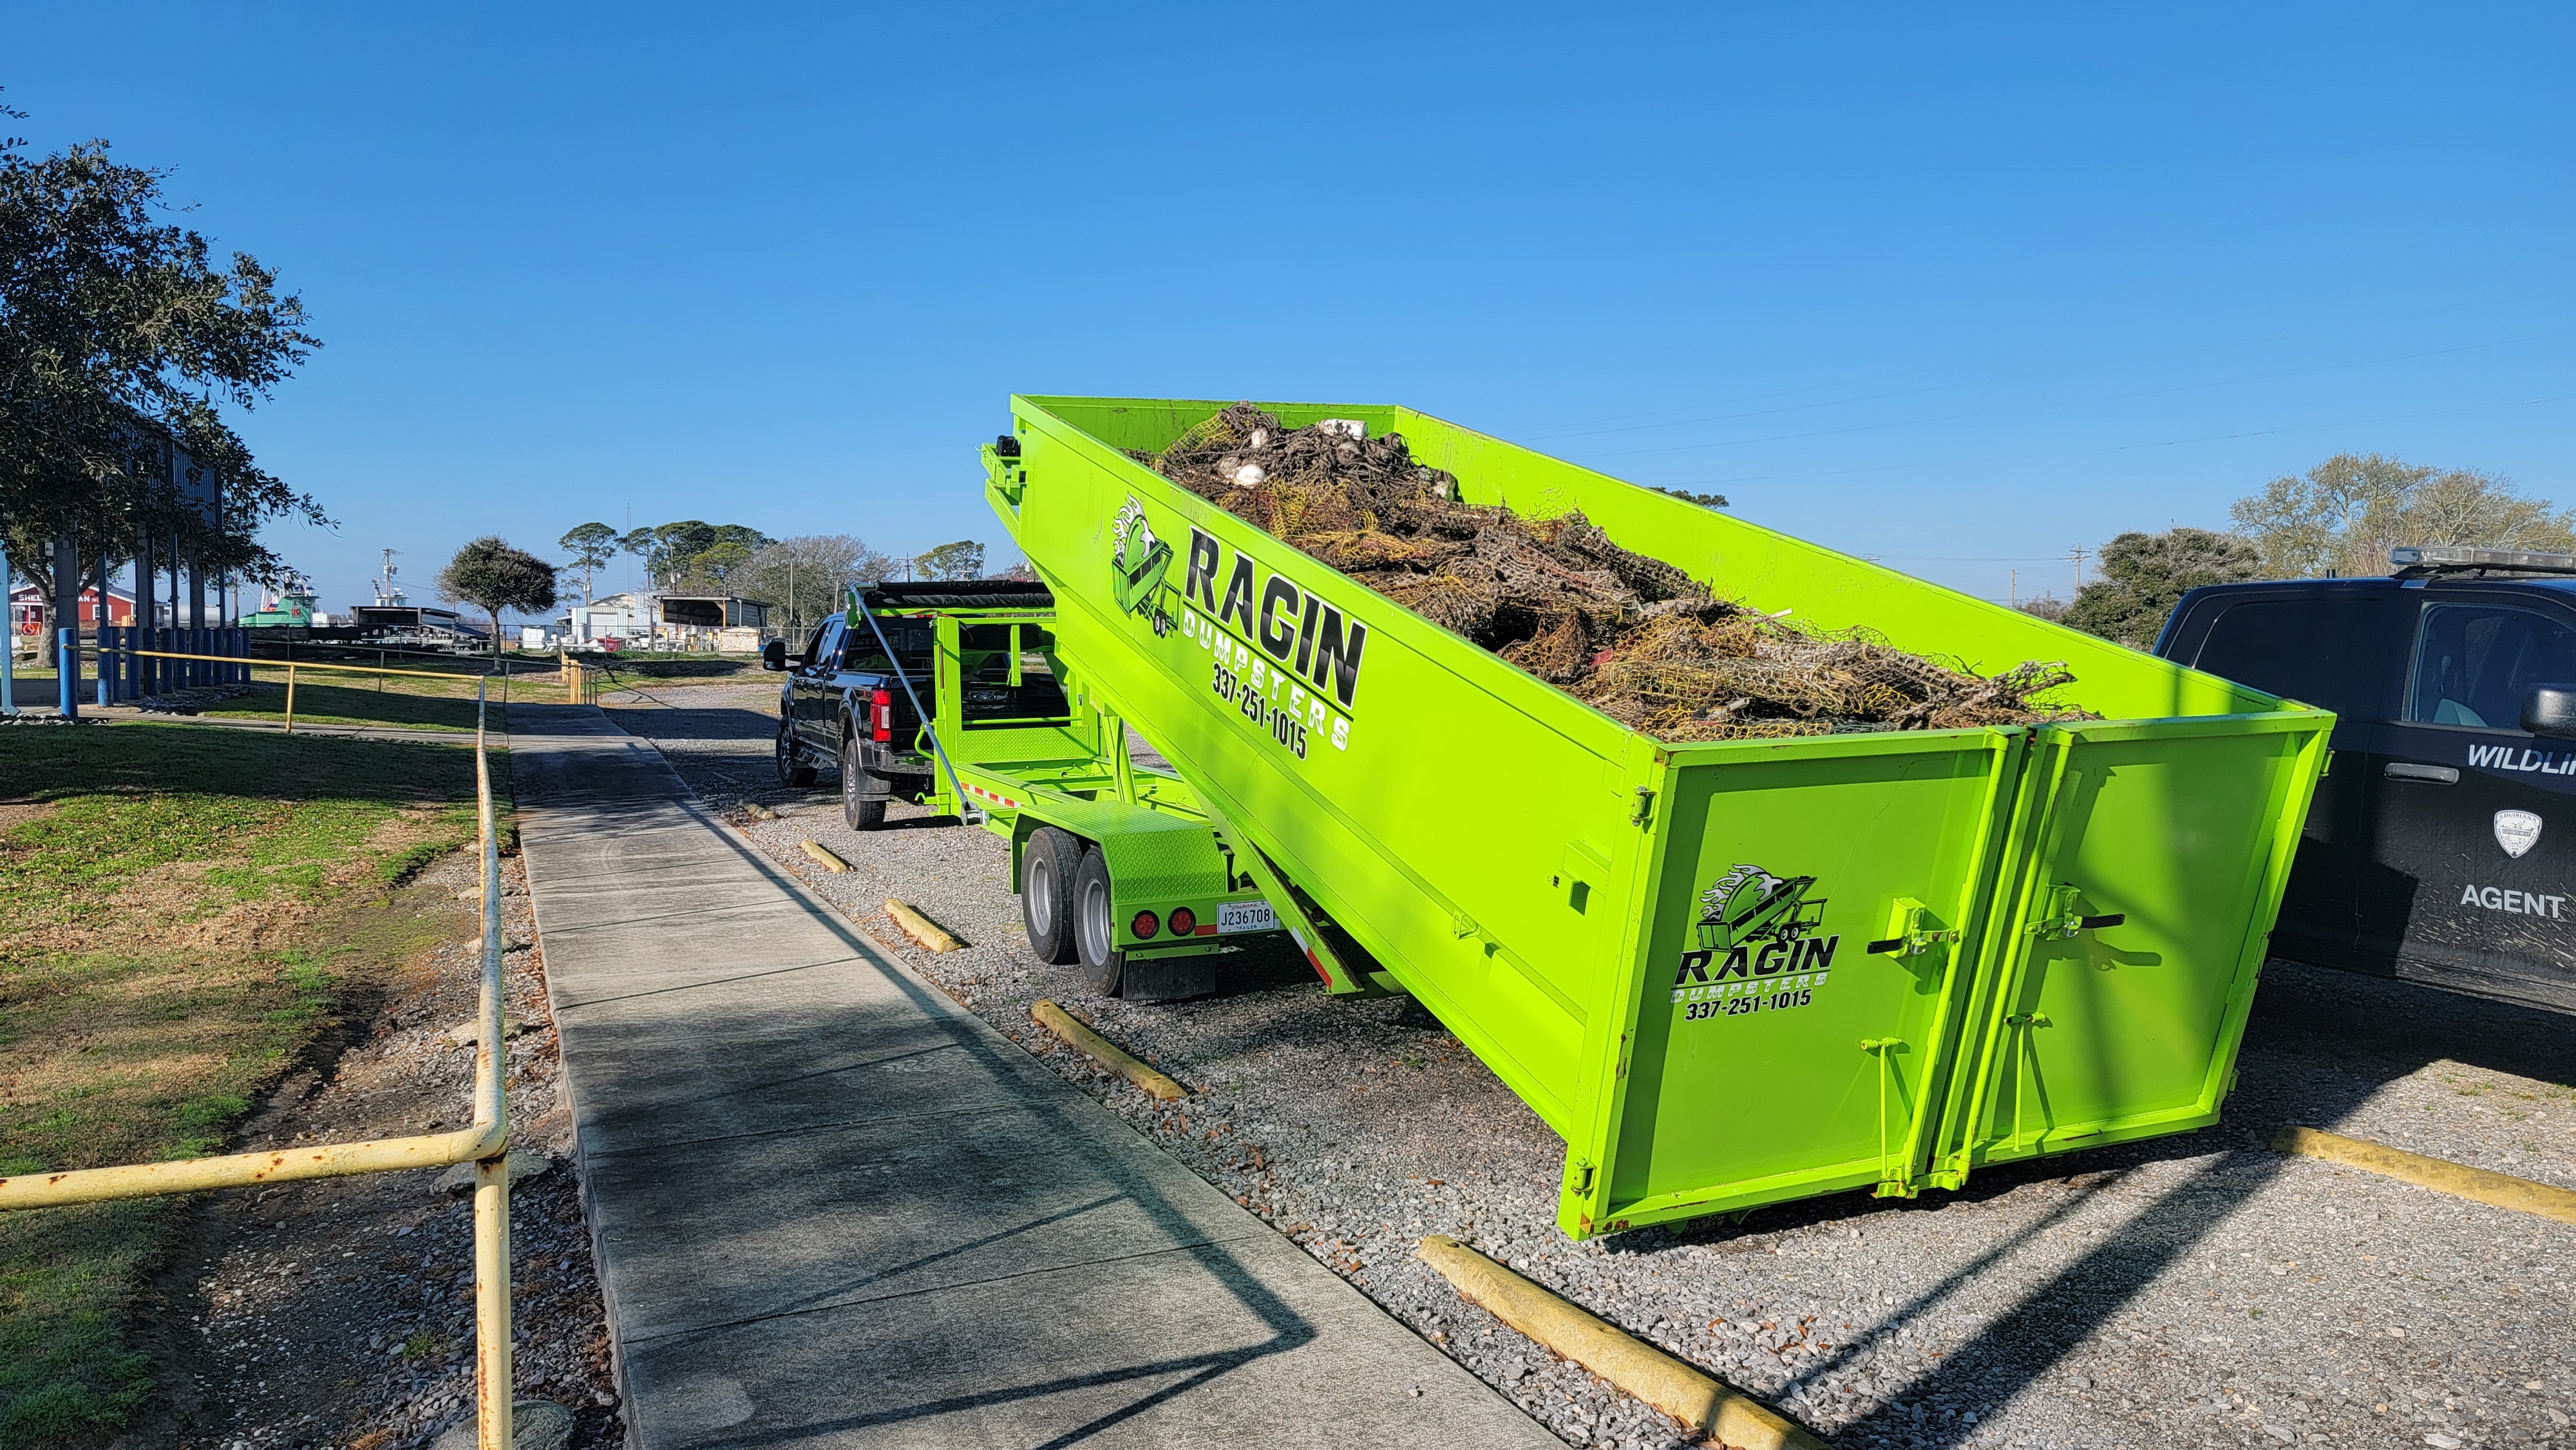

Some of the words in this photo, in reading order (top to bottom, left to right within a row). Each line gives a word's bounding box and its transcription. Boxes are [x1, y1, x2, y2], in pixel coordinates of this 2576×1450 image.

[1184, 525, 1367, 711] RAGIN
[1182, 608, 1350, 751] DUMPSTERS
[1212, 662, 1307, 761] 337-251-1015
[2499, 813, 2537, 823] LOUISIANA
[1221, 909, 1270, 925] J236708
[2461, 884, 2566, 918] AGENT
[1674, 935, 1840, 986] RAGIN
[1670, 972, 1828, 1003] DUMPSTERS
[1684, 988, 1812, 1021] 337-251-1015
